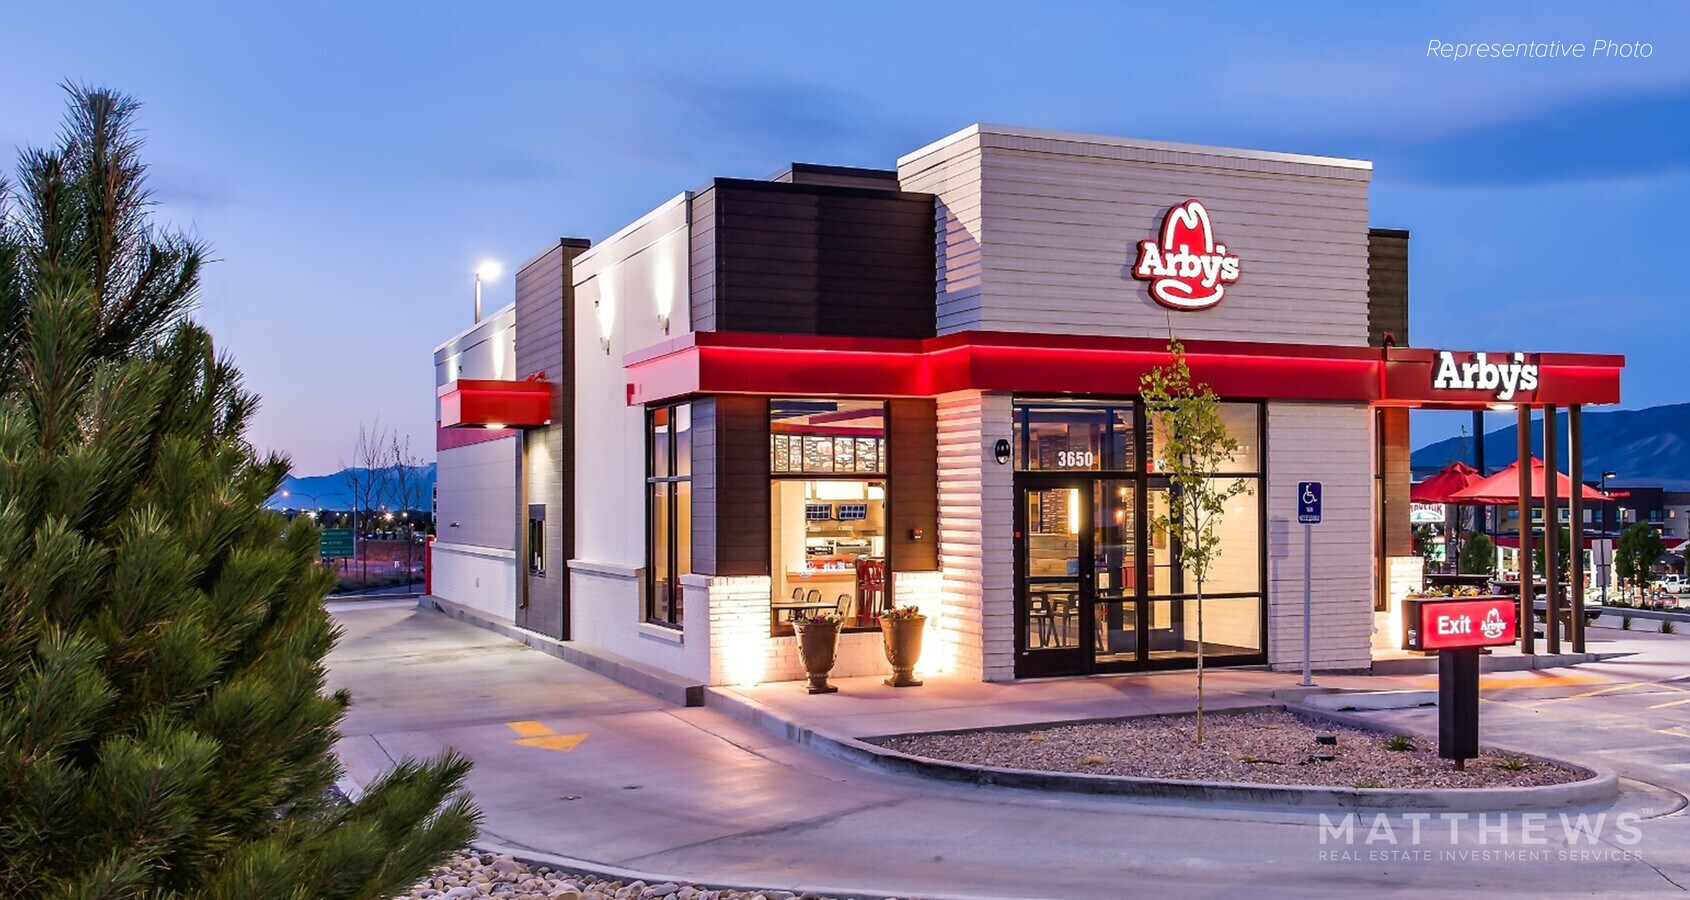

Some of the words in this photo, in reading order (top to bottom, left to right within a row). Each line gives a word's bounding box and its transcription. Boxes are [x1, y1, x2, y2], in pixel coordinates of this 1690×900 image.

[1139, 242, 1240, 288] Arby's
[1434, 351, 1538, 400] Arby's
[1058, 451, 1093, 467] 3650
[1438, 615, 1471, 634] Exit
